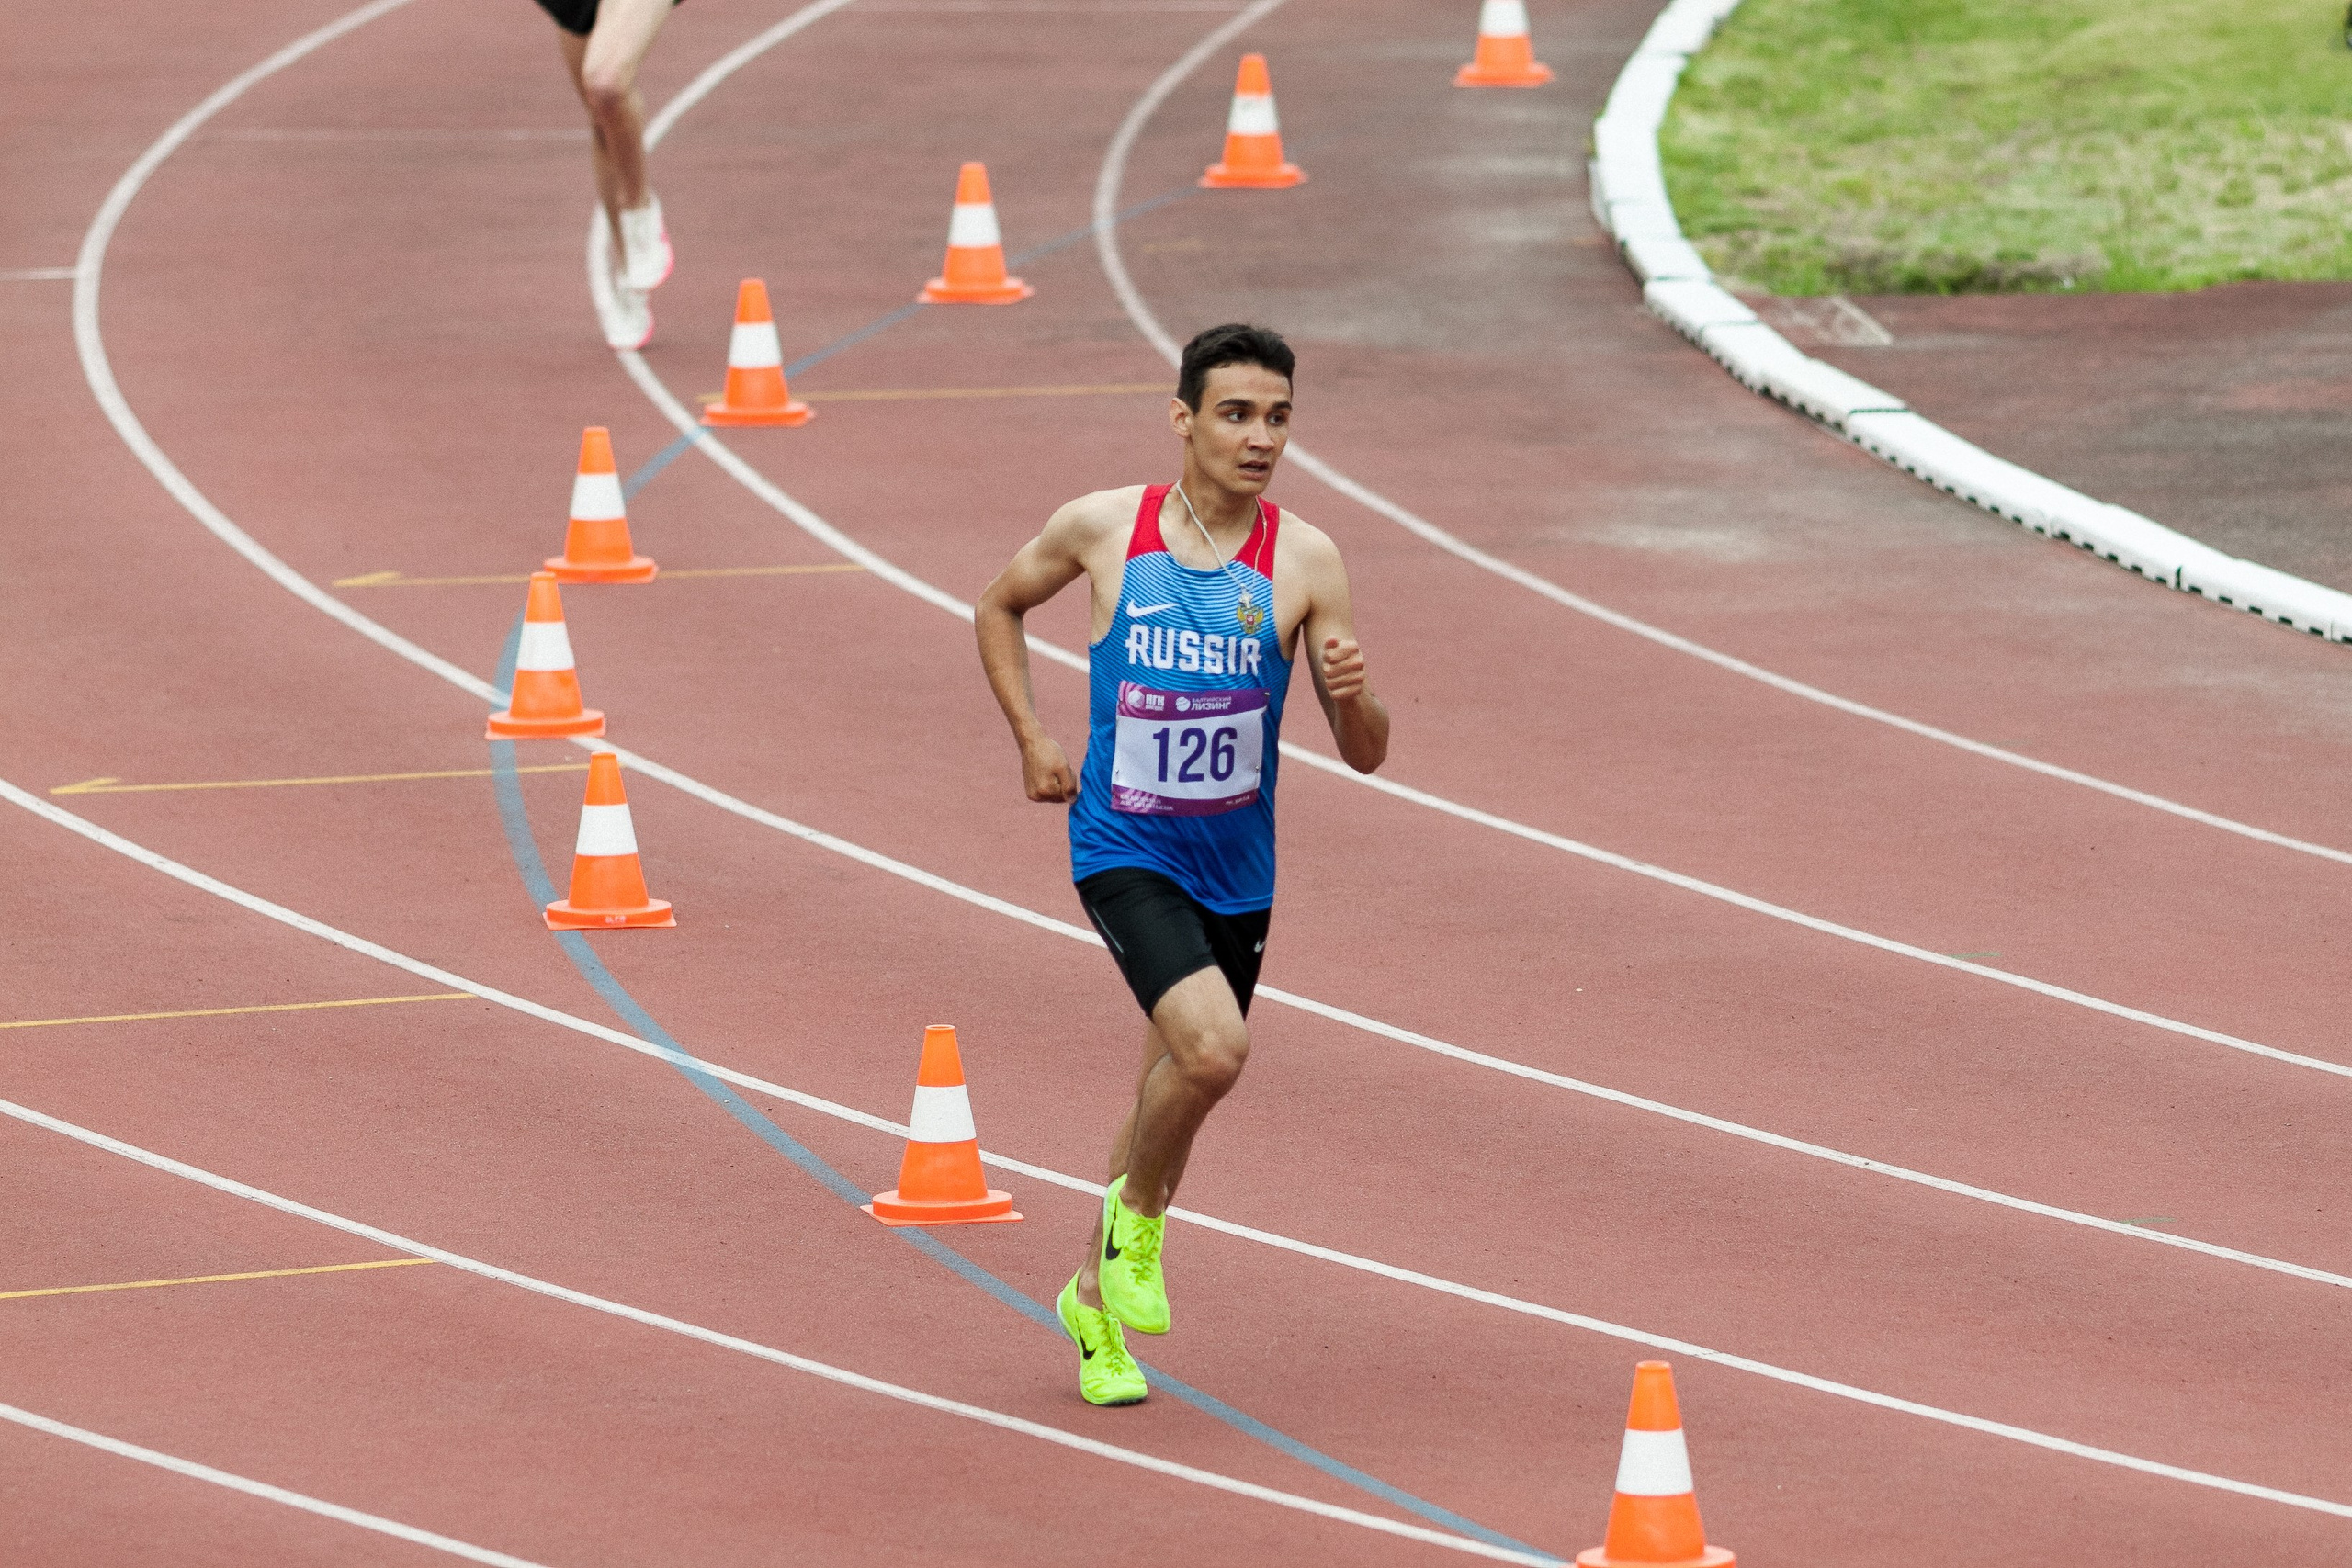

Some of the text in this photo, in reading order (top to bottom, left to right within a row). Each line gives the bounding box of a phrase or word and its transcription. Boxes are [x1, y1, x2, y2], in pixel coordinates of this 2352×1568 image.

[1125, 624, 1262, 675] RUSSIA
[1191, 702, 1231, 711] ЛИЗИНГ
[1153, 726, 1238, 783] 126
